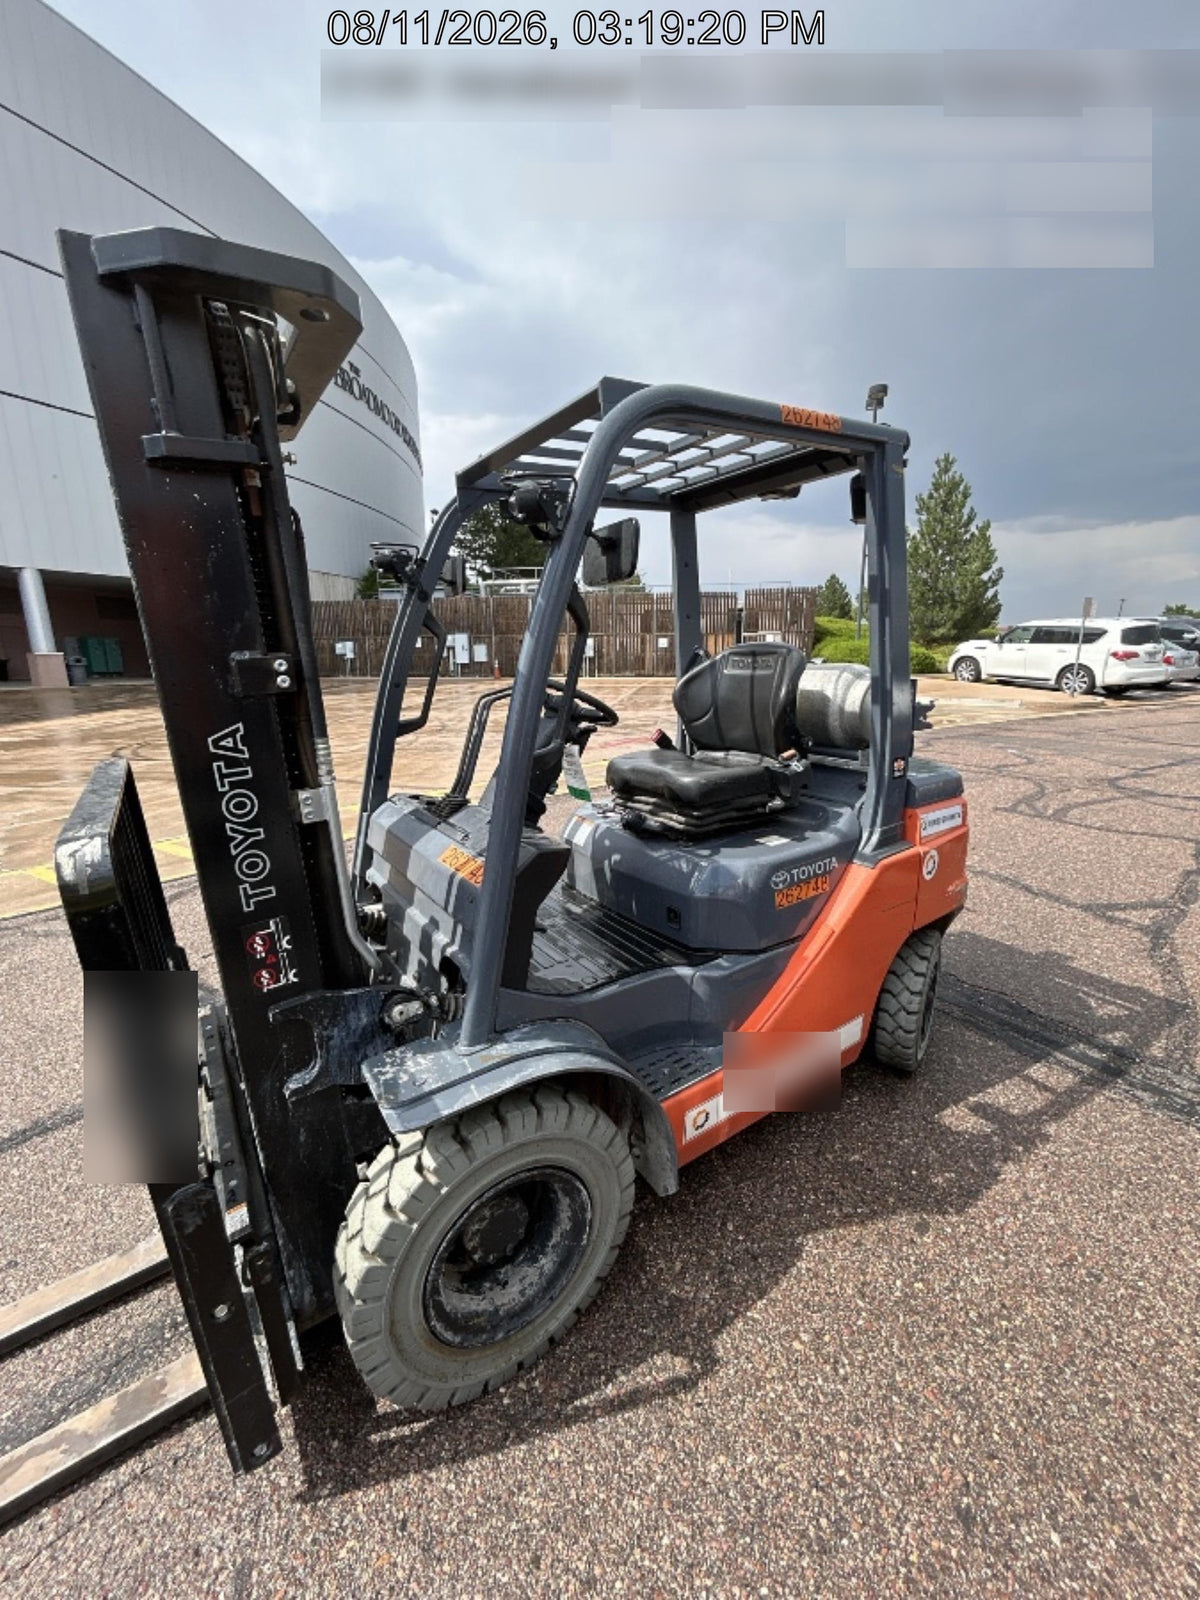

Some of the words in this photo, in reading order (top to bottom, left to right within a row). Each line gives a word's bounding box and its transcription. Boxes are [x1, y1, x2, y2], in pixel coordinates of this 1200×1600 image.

[781, 404, 842, 431] 262748
[207, 721, 277, 912] TOYOTA
[791, 856, 838, 882] TOYOTA
[775, 875, 828, 908] 262748
